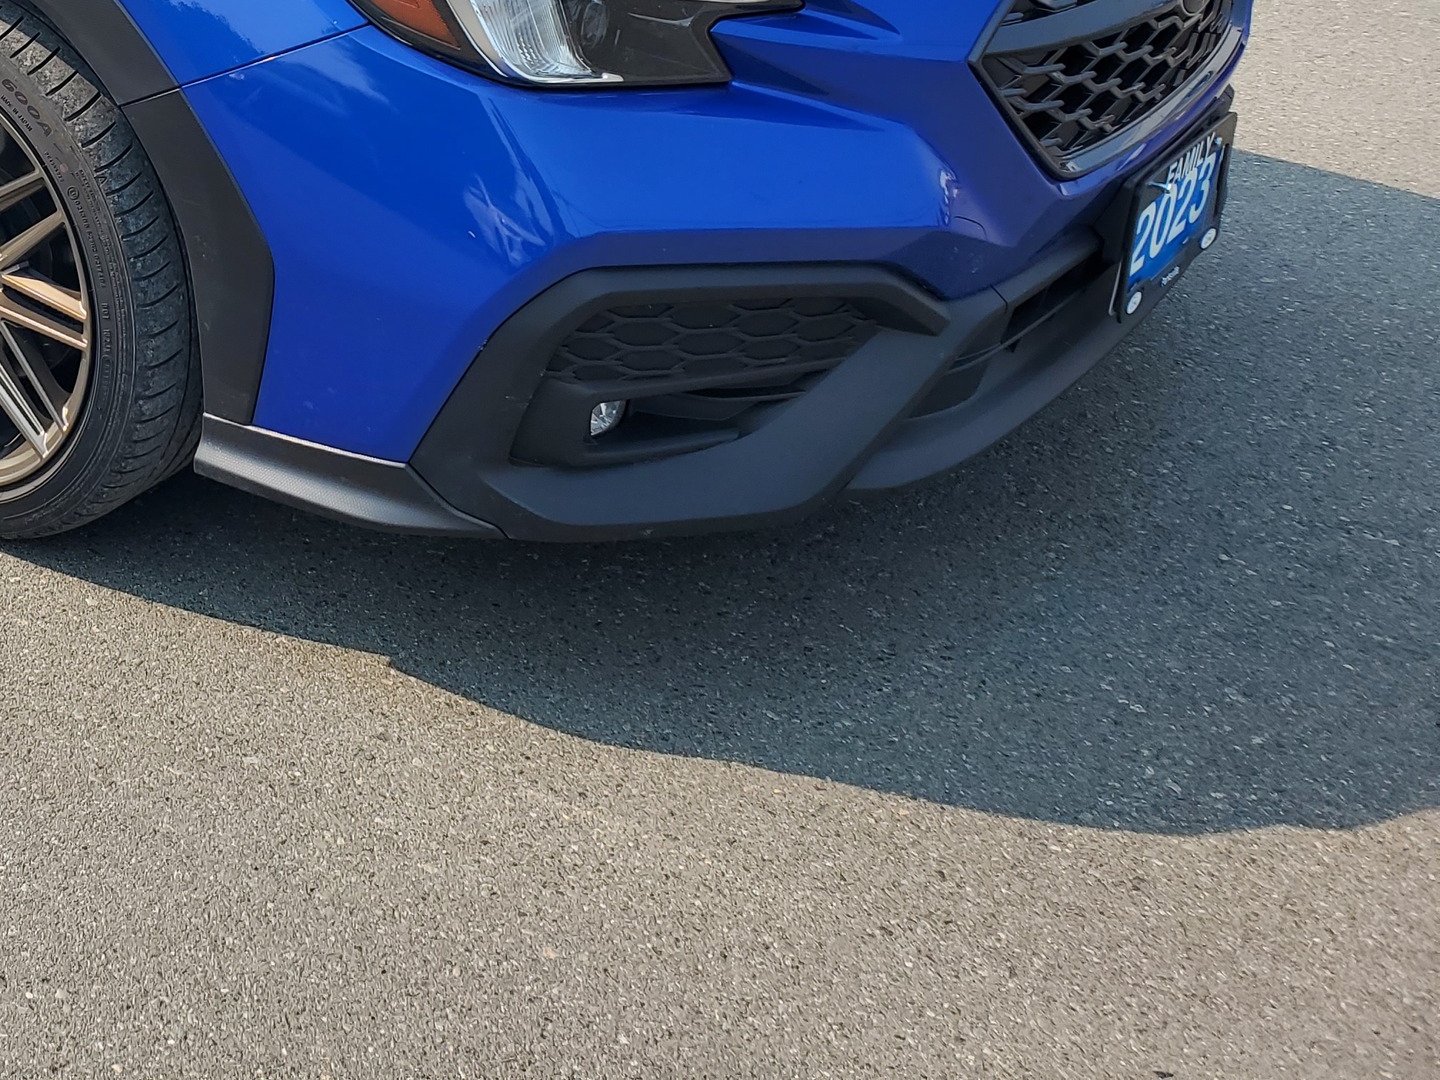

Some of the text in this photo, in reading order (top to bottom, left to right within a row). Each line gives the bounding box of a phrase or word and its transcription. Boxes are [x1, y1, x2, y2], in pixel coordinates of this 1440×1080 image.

[1, 78, 53, 137] 600A
[1165, 132, 1216, 184] FAMILY
[1129, 151, 1216, 277] 2023
